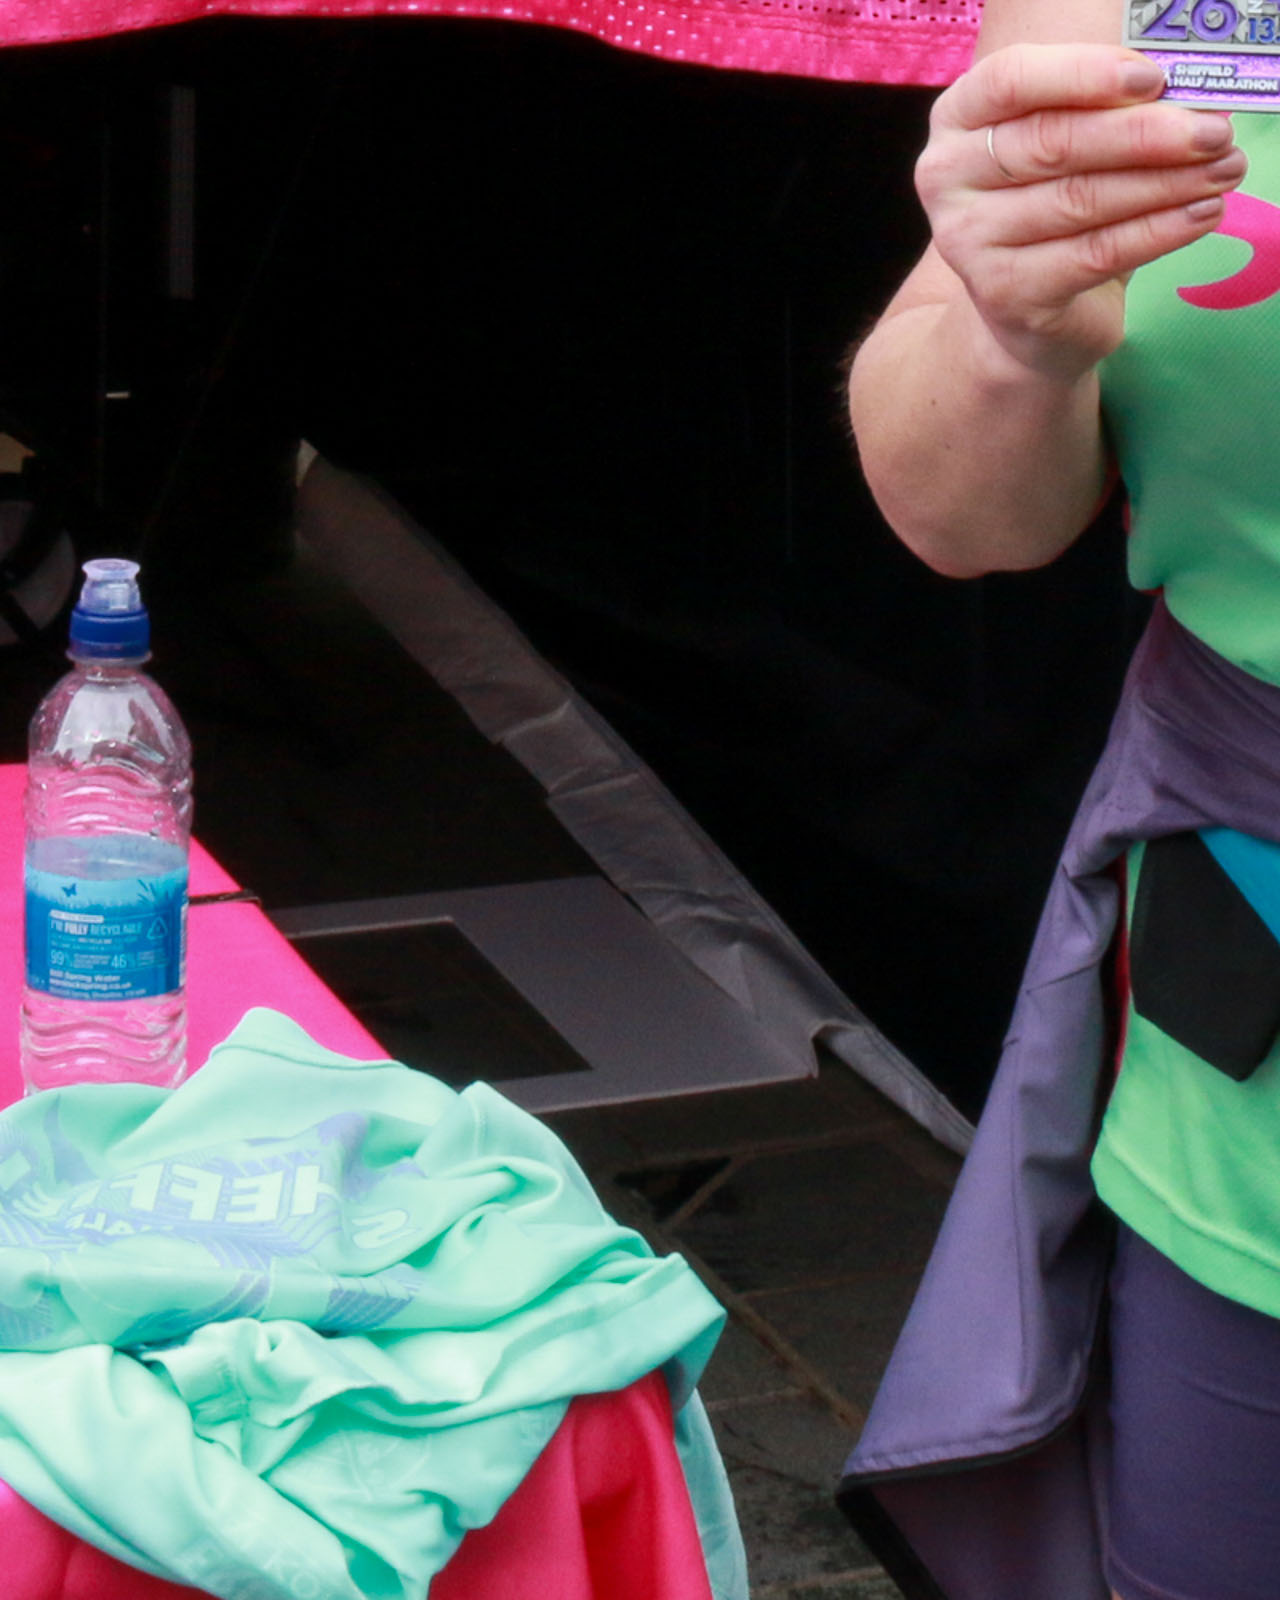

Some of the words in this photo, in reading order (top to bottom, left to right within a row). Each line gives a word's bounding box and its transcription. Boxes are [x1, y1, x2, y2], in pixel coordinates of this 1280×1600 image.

[1174, 63, 1234, 77] SHEFFIELD
[1173, 75, 1205, 88] HALF
[1205, 77, 1280, 92] MARATHON
[64, 921, 89, 935] FULLY
